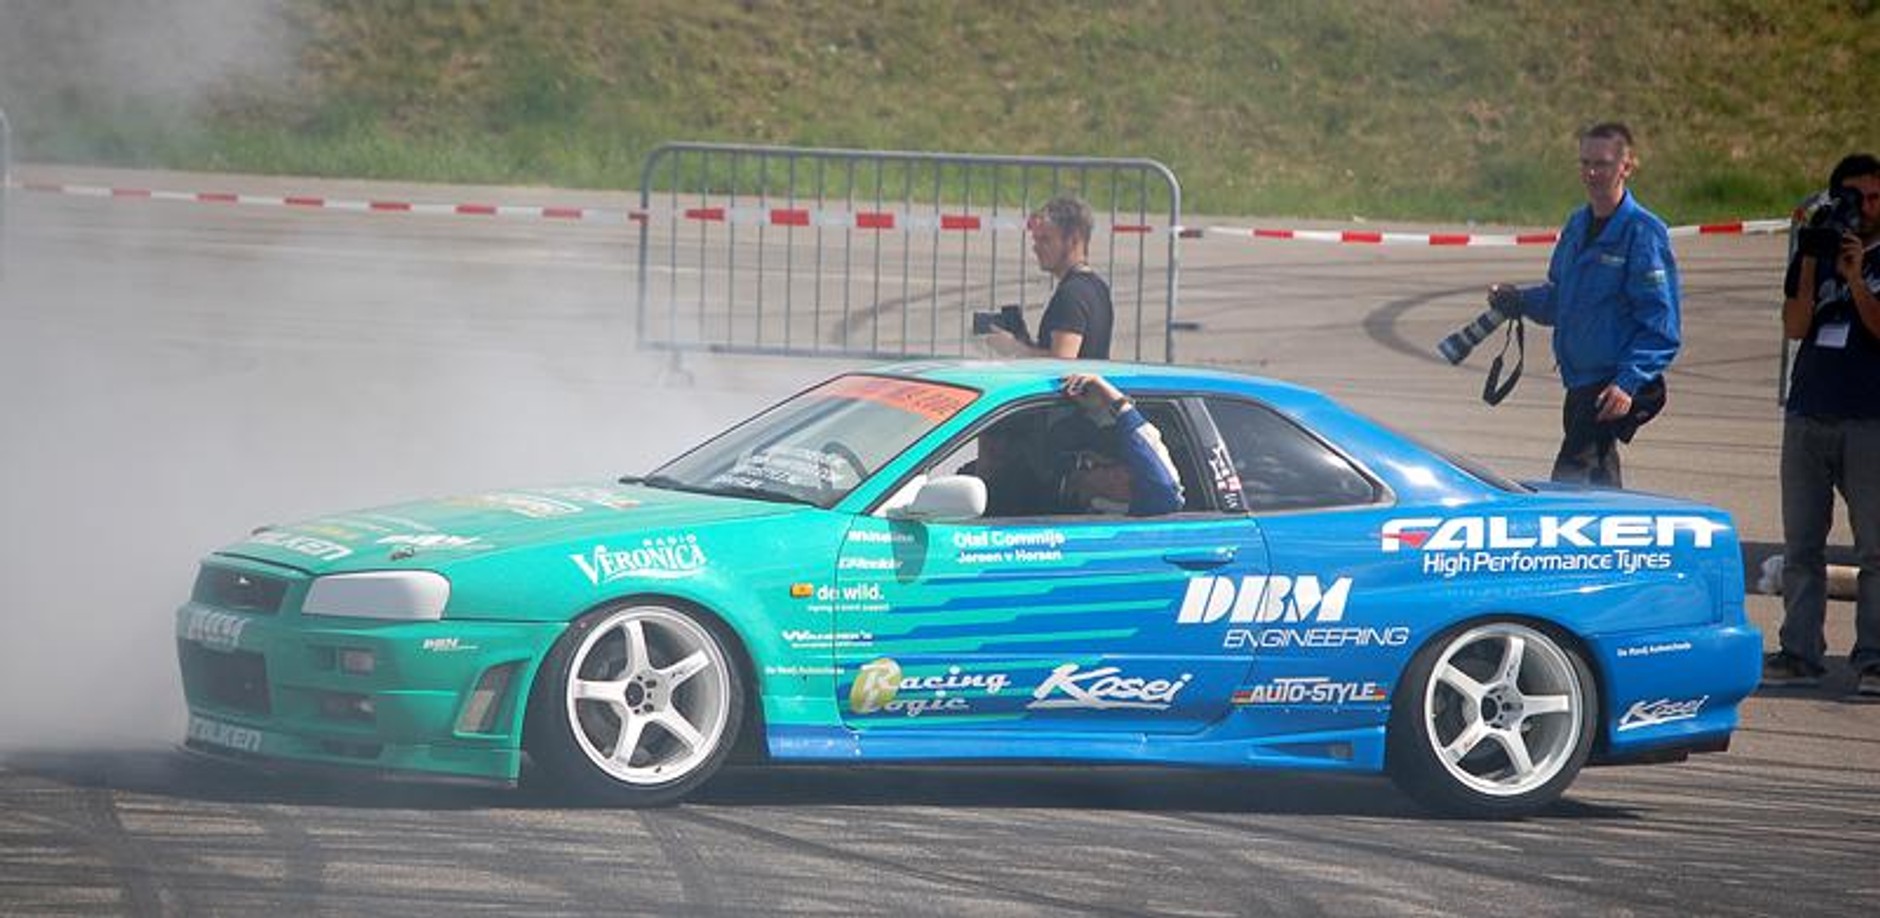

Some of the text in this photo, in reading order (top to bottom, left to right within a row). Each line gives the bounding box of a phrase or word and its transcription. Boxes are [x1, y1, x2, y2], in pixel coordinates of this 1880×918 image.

[1382, 516, 1722, 552] FALKEN
[1423, 549, 1672, 577] High Performance Tyres
[1177, 575, 1353, 623] DBM
[1223, 626, 1410, 648] ENGINEERING
[862, 657, 1012, 695] Racing
[1031, 663, 1193, 706] Kosei
[1250, 677, 1379, 705] AUTO-STYLE
